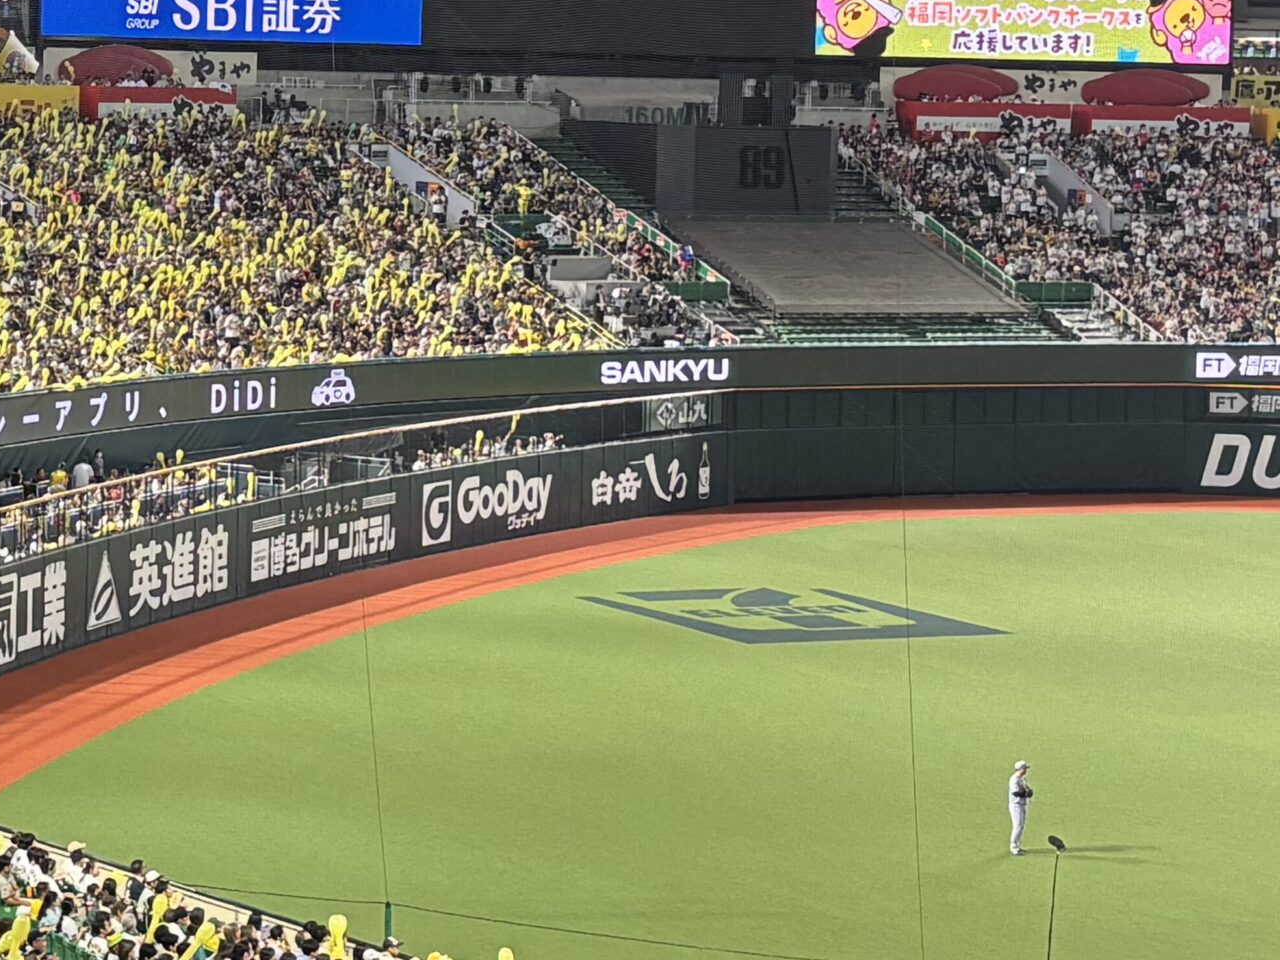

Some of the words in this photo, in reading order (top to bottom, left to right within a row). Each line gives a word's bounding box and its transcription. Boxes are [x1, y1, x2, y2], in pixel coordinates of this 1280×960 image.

[126, 18, 159, 30] GROUP
[908, 1, 1143, 26] 福岡ソフトバンクホークスを
[952, 30, 1091, 53] 応援しています!
[190, 51, 251, 83] やまや
[1024, 73, 1077, 93] やまや
[601, 358, 729, 385] SANKYU
[1203, 358, 1225, 373] FT
[209, 382, 277, 415] DiDi
[1216, 396, 1237, 410] FT
[678, 401, 708, 423] 山九
[457, 469, 553, 525] GooDay
[271, 514, 396, 577] 博多グリーンホテル
[128, 524, 229, 617] 英進館
